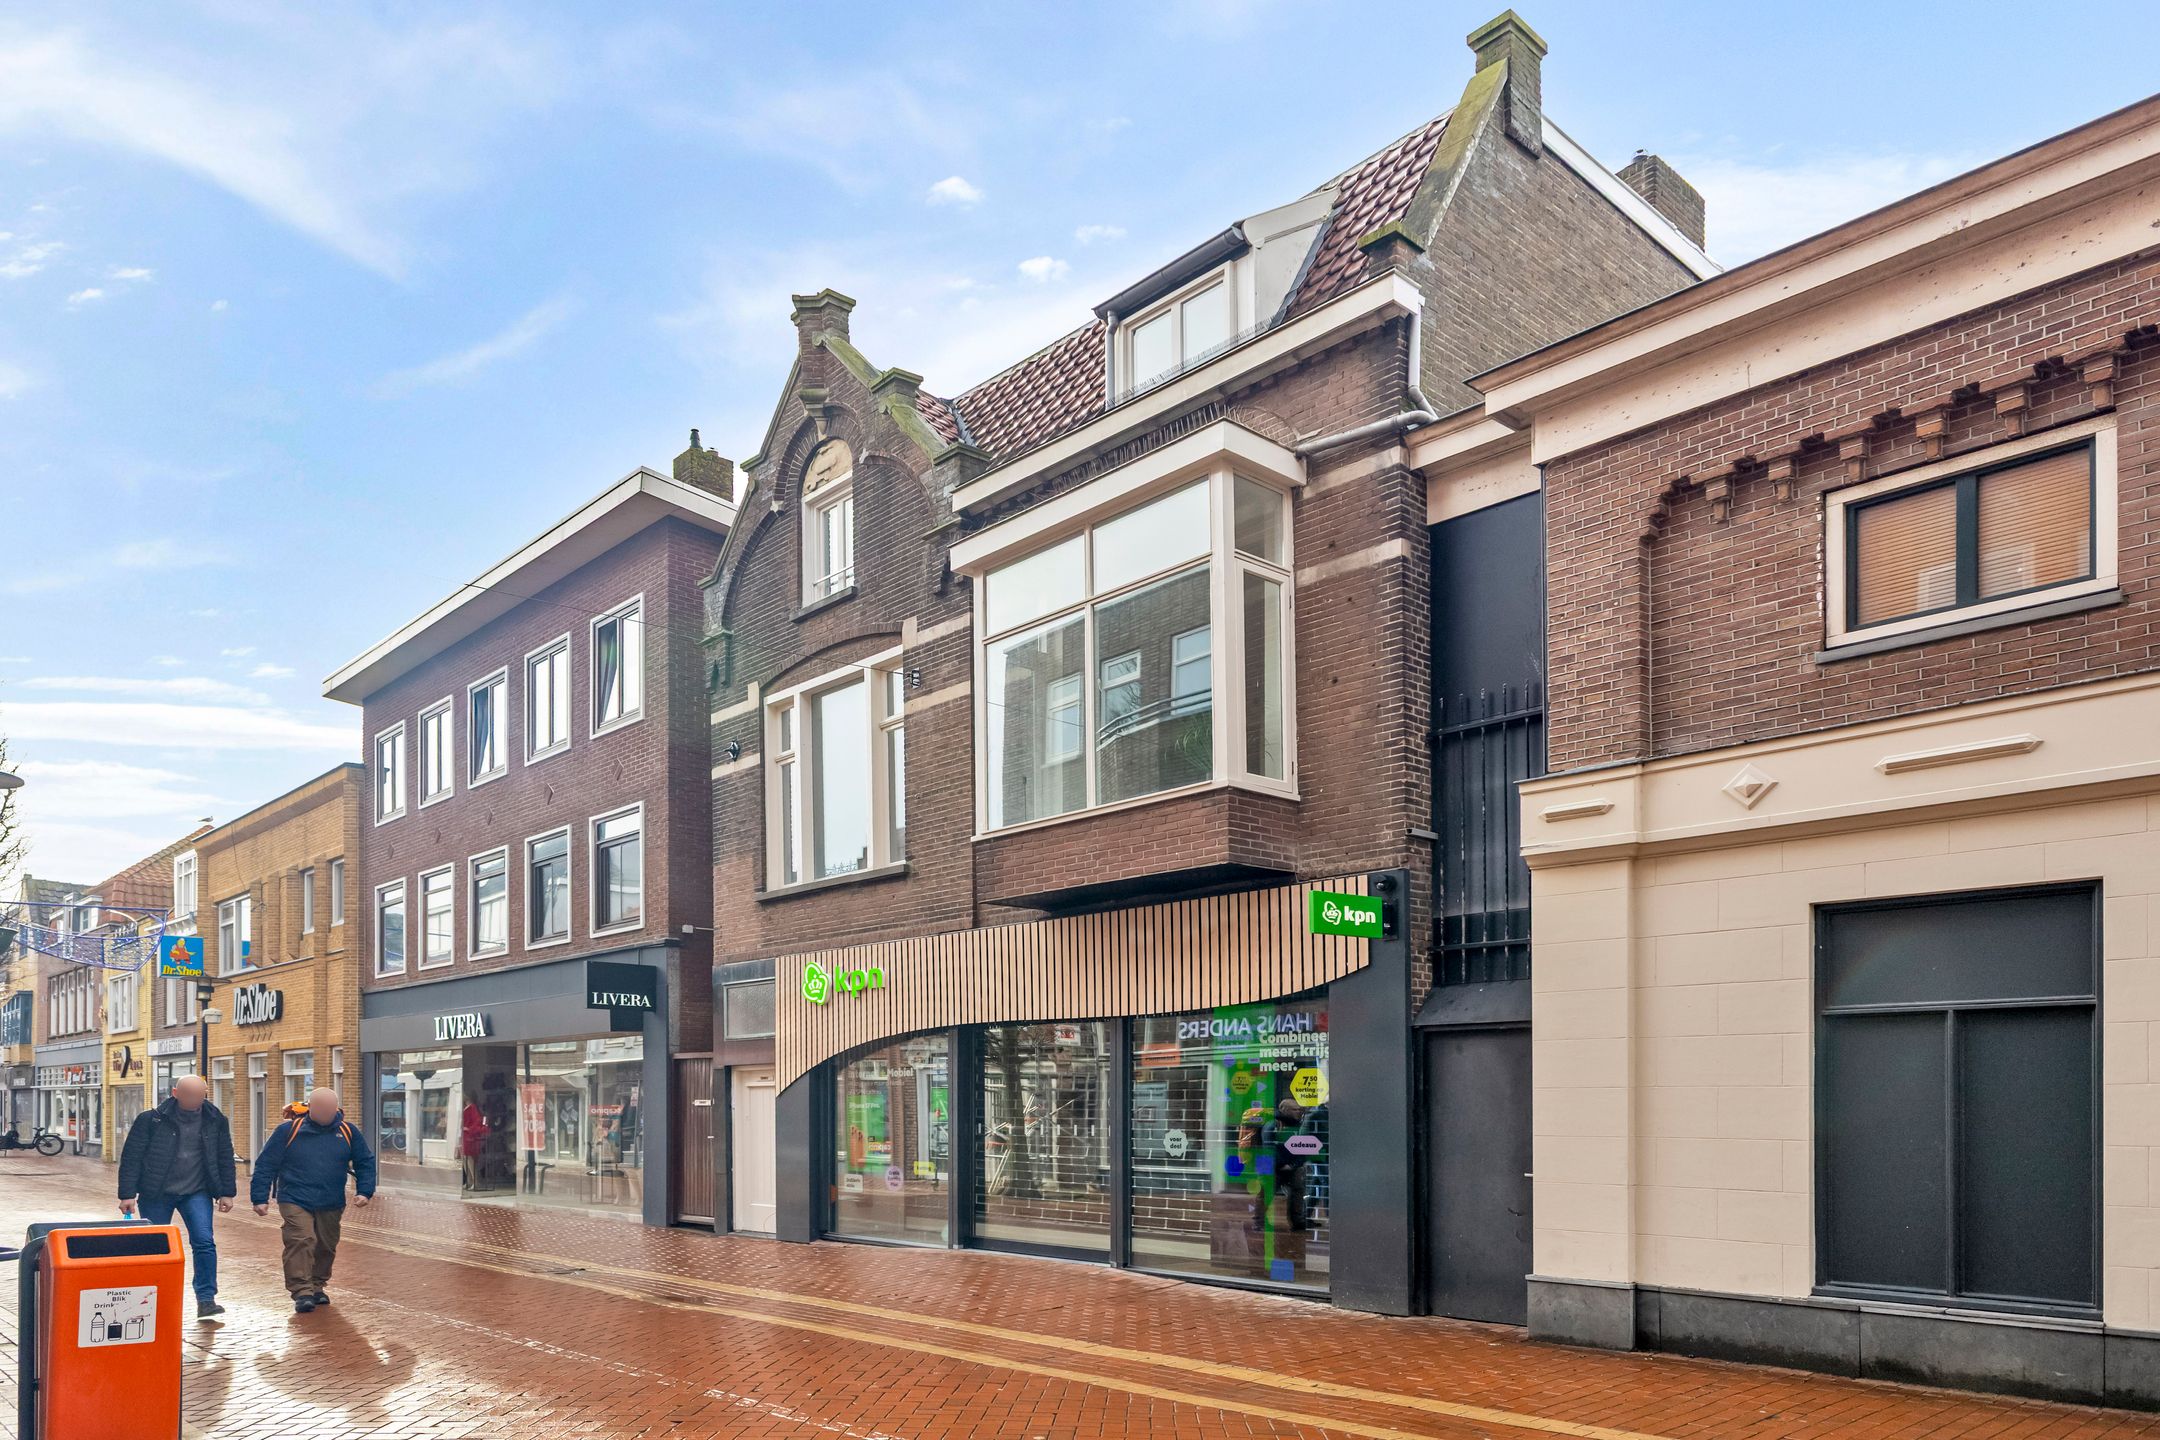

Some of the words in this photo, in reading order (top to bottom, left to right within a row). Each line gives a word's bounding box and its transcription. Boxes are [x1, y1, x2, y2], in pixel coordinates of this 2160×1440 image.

[1344, 905, 1376, 926] kpn
[162, 965, 202, 976] Dr.Shoe
[835, 965, 885, 1000] kpn
[232, 983, 278, 1025] Dr.Shoe
[592, 992, 651, 1008] LIVERA
[434, 1012, 486, 1041] LIVERA
[1260, 1030, 1329, 1043] Combinee
[1260, 1047, 1297, 1058] meer,
[888, 1067, 914, 1077] Mobiel
[1260, 1061, 1298, 1071] meer.
[1302, 1075, 1318, 1087] 7,50
[524, 1103, 544, 1113] SALE
